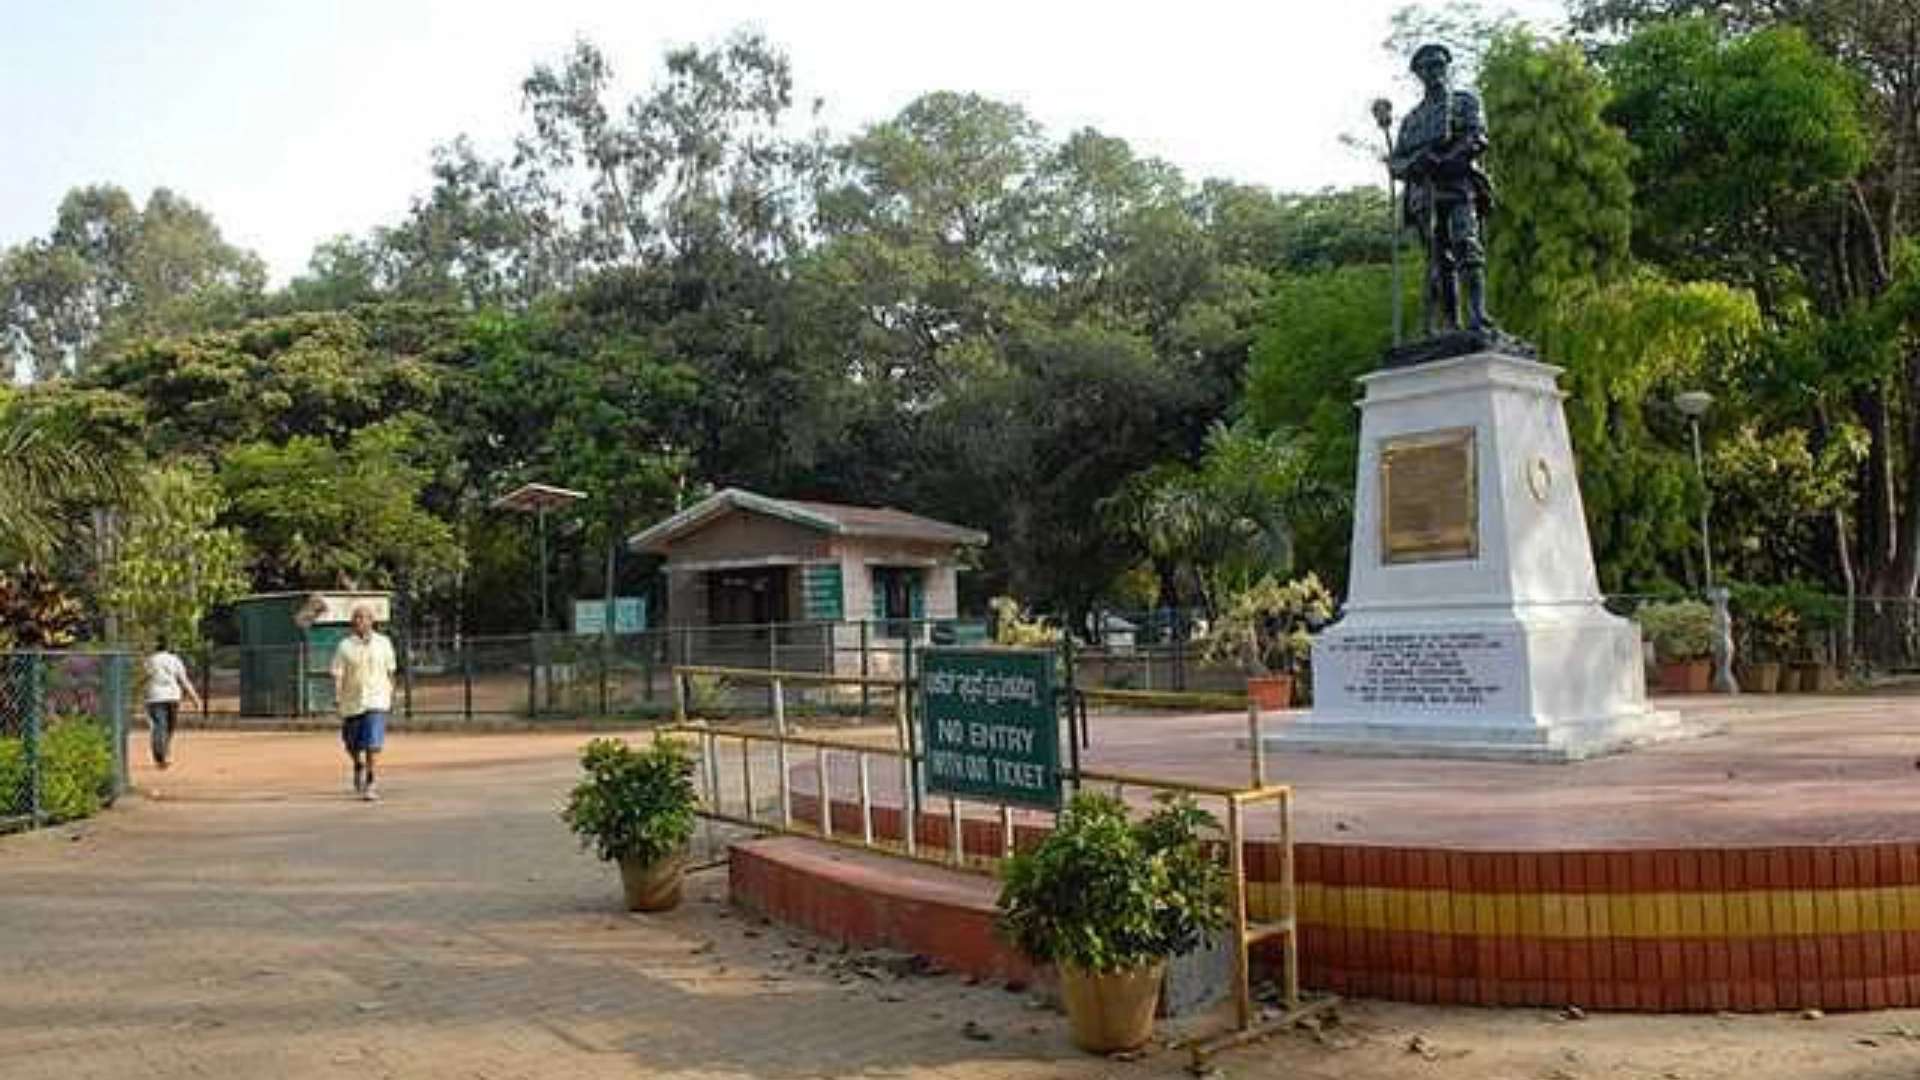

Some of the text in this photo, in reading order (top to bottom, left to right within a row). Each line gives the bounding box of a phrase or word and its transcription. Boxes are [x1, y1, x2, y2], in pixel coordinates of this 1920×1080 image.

[937, 718, 1036, 753] NO ENTRY
[991, 757, 1045, 789] TICKET
